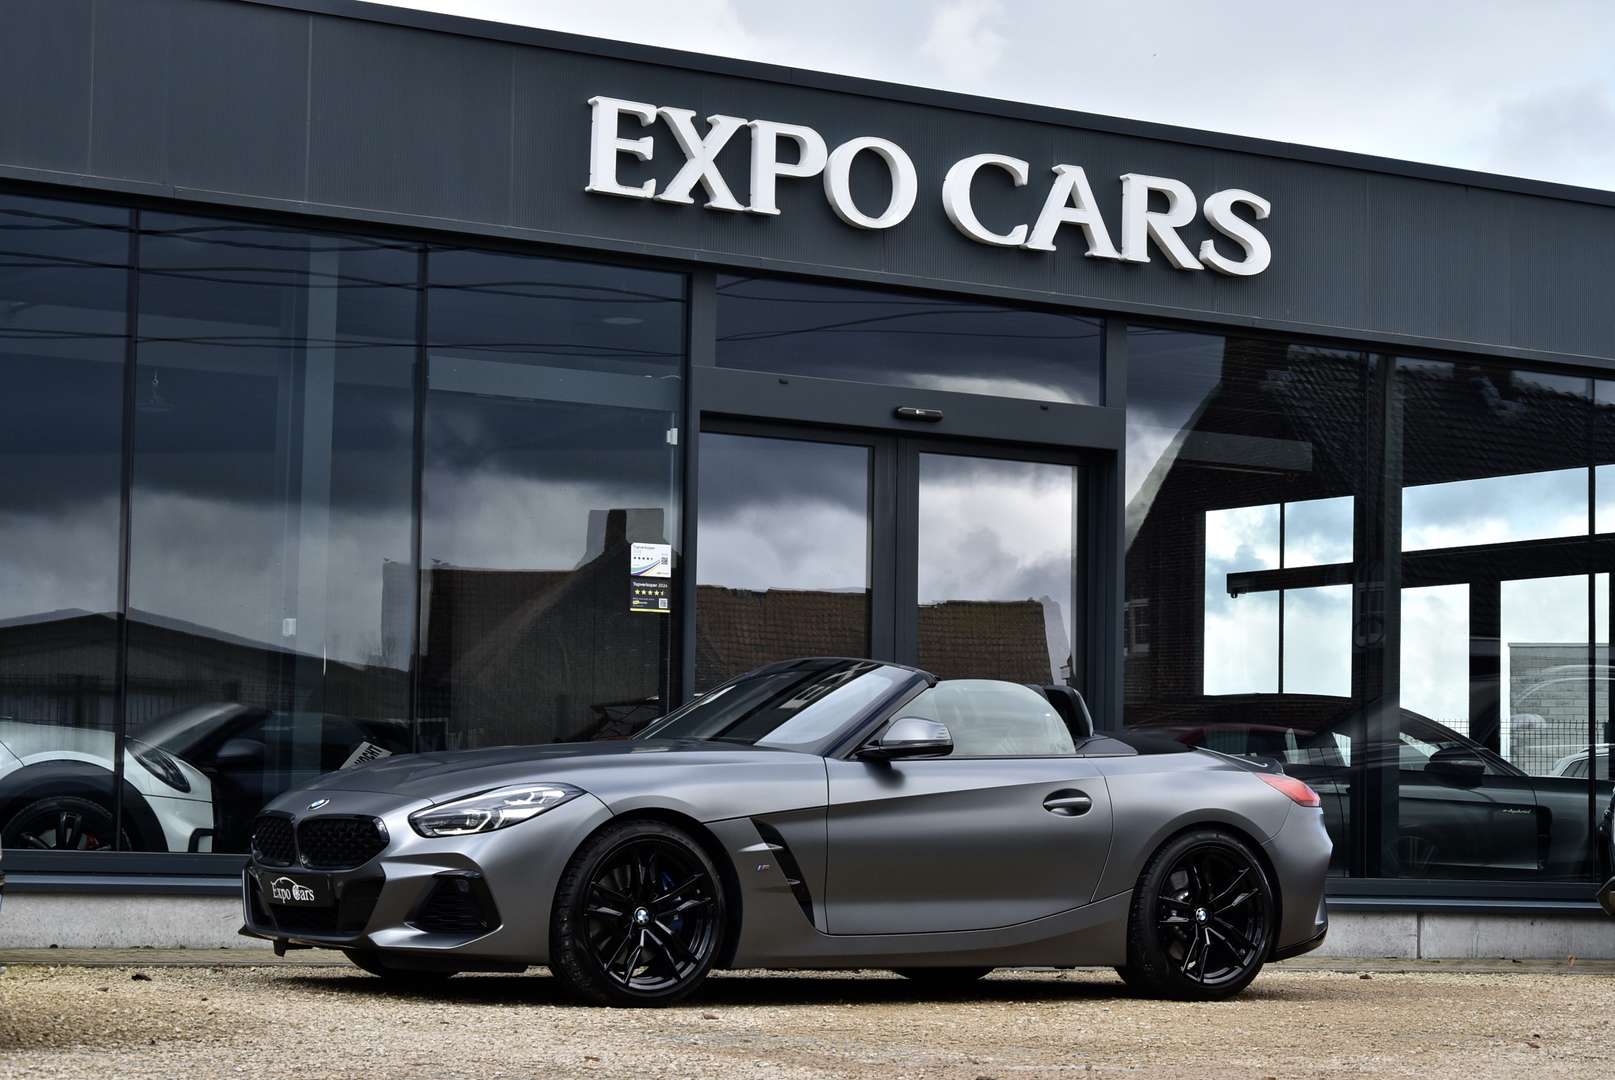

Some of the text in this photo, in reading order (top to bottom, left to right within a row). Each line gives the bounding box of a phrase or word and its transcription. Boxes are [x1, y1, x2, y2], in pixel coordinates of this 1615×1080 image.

[585, 95, 1272, 278] EXPO CARS
[271, 884, 315, 903] Expo Cars
